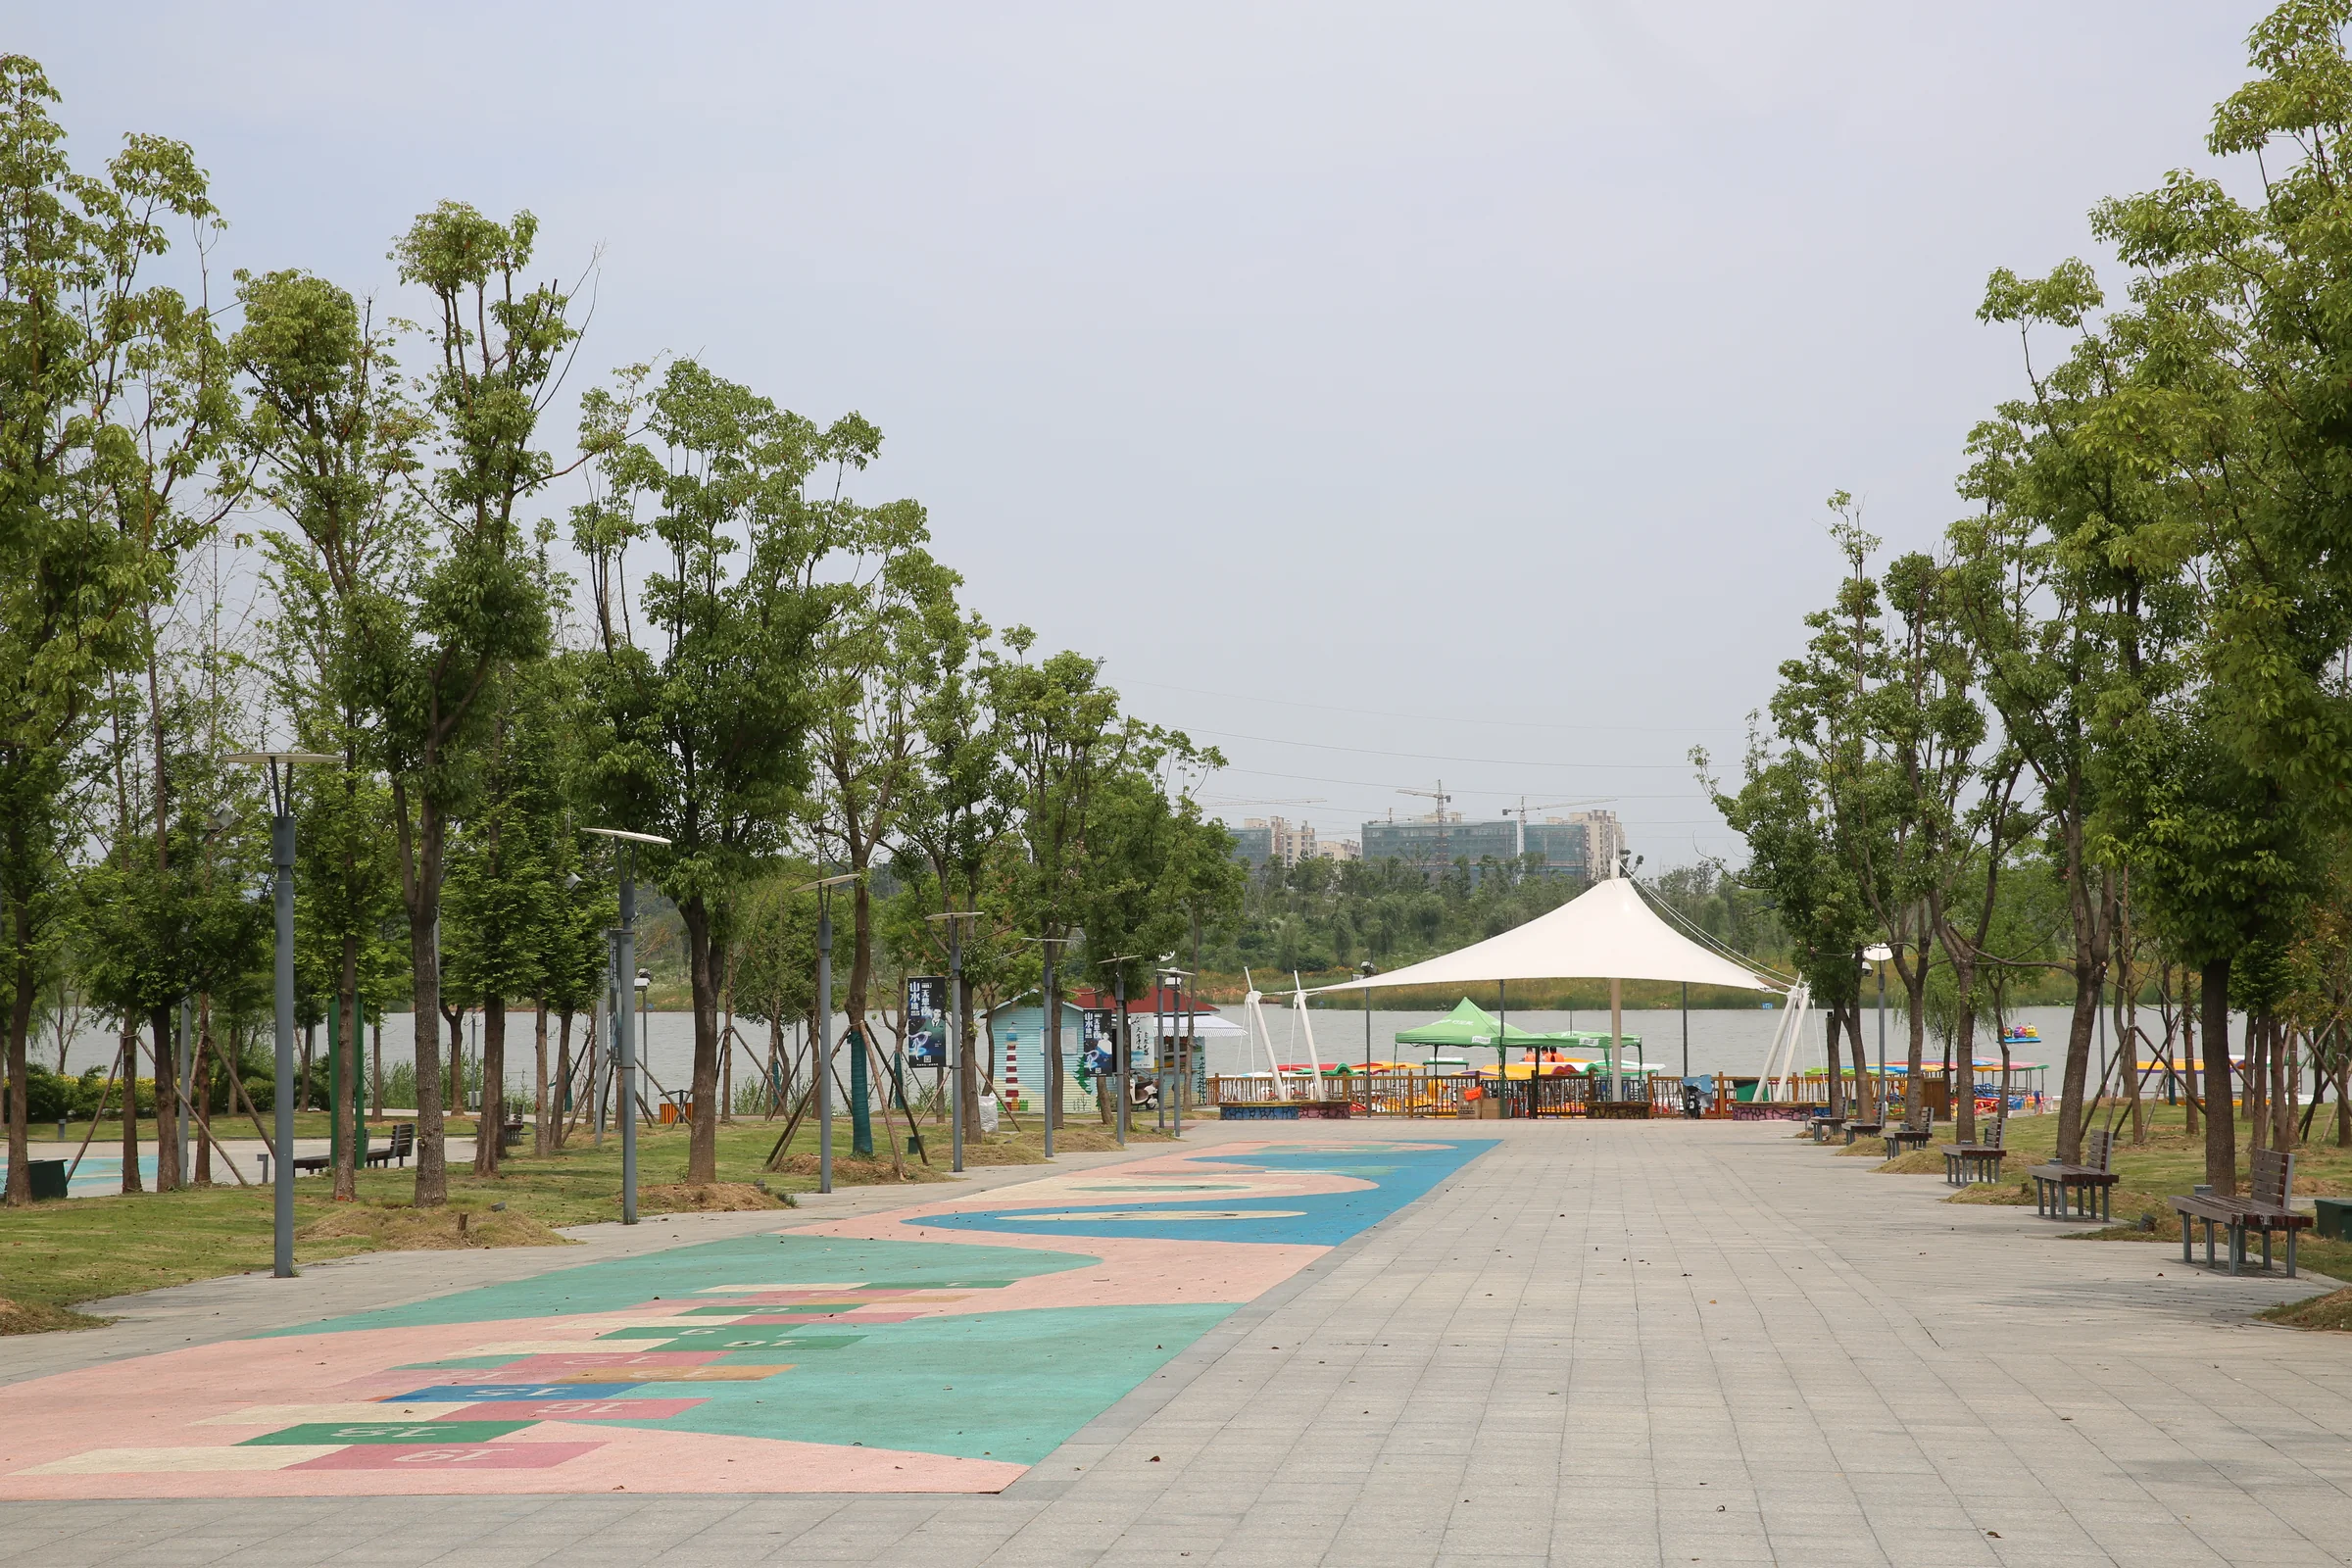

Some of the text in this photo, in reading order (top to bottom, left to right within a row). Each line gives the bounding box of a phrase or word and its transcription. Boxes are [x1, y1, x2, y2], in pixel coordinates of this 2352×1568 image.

[909, 981, 920, 1010] 山水境
[466, 1387, 573, 1397] 15
[535, 1401, 643, 1414] 16
[330, 1426, 458, 1438] 18
[392, 1447, 514, 1462] 19
